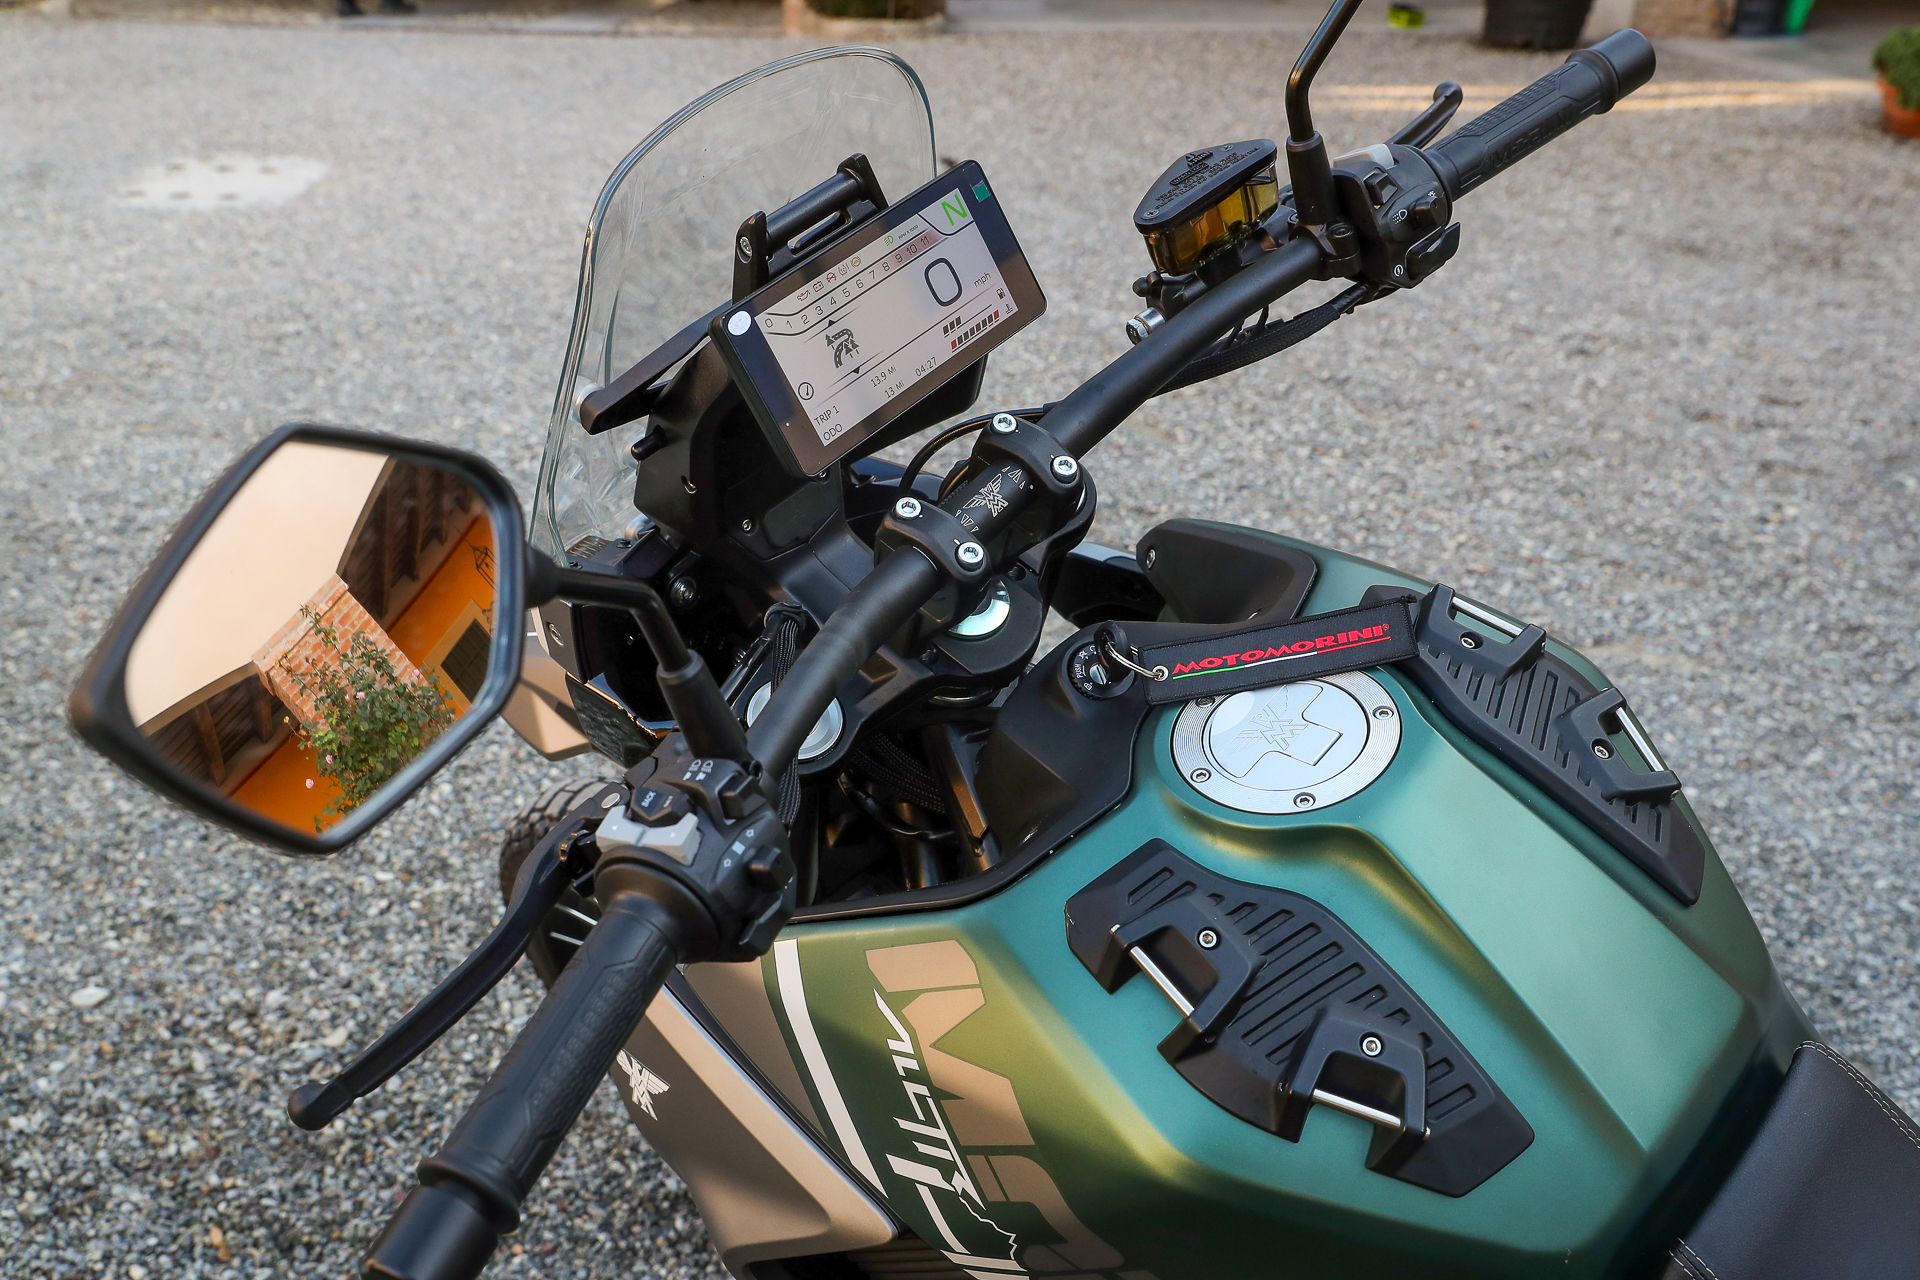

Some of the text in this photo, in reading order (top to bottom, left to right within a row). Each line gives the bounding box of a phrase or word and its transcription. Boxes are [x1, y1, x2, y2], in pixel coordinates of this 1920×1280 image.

[942, 194, 967, 226] N
[764, 236, 930, 329] 0 1 2 3 4 5 6 7 8 9 10 11
[924, 257, 963, 306] 0
[973, 272, 992, 288] mph
[870, 364, 897, 388] 13.9 Mi
[914, 356, 938, 377] 04:27
[884, 379, 905, 399] 13 Mi
[814, 405, 840, 426] TRIP 1
[823, 423, 843, 441] ODO
[1075, 663, 1083, 678] PUSH
